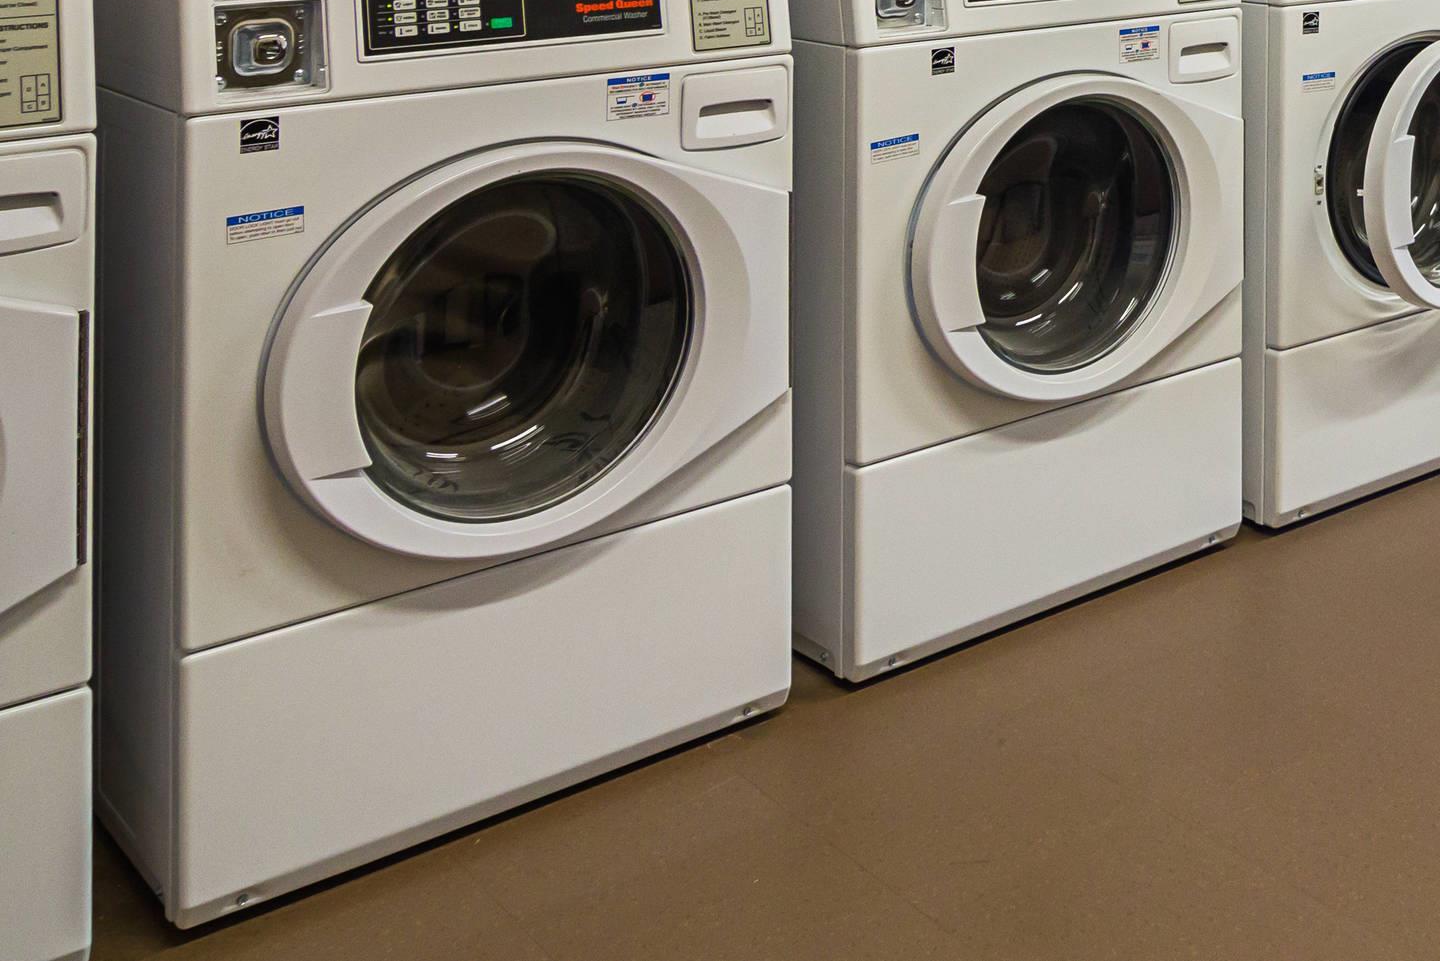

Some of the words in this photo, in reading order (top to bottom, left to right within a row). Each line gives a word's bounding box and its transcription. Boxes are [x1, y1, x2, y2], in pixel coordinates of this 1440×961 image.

[576, 0, 614, 13] Speed
[615, 0, 653, 9] Queen
[582, 13, 622, 23] Commercial
[877, 135, 913, 147] NOTICE
[238, 209, 295, 223] NOTICE
